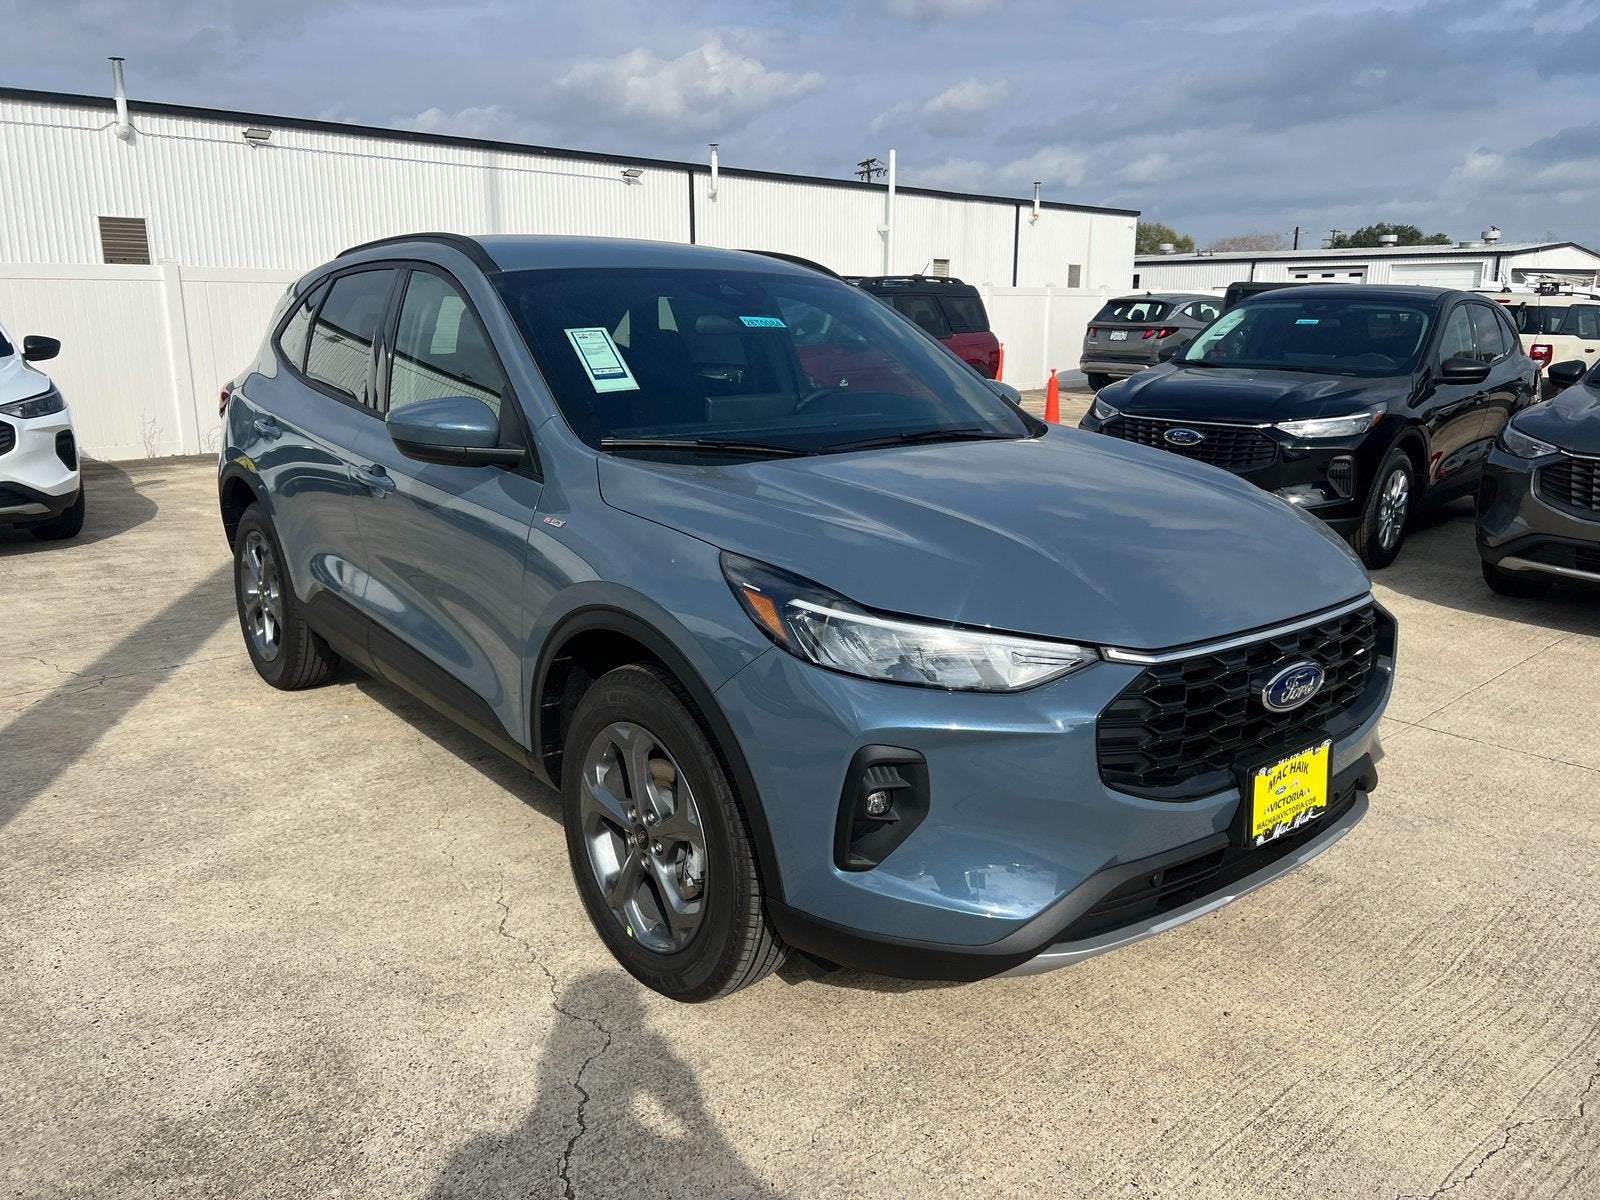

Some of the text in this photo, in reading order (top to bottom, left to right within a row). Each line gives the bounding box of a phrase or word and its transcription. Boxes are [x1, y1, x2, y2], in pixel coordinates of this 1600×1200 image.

[1281, 672, 1315, 703] Ford
[1268, 764, 1289, 791] MAC
[1289, 760, 1309, 775] HAIK
[1269, 789, 1304, 812] VICTORIA
[1272, 808, 1318, 839] Mac Haik
